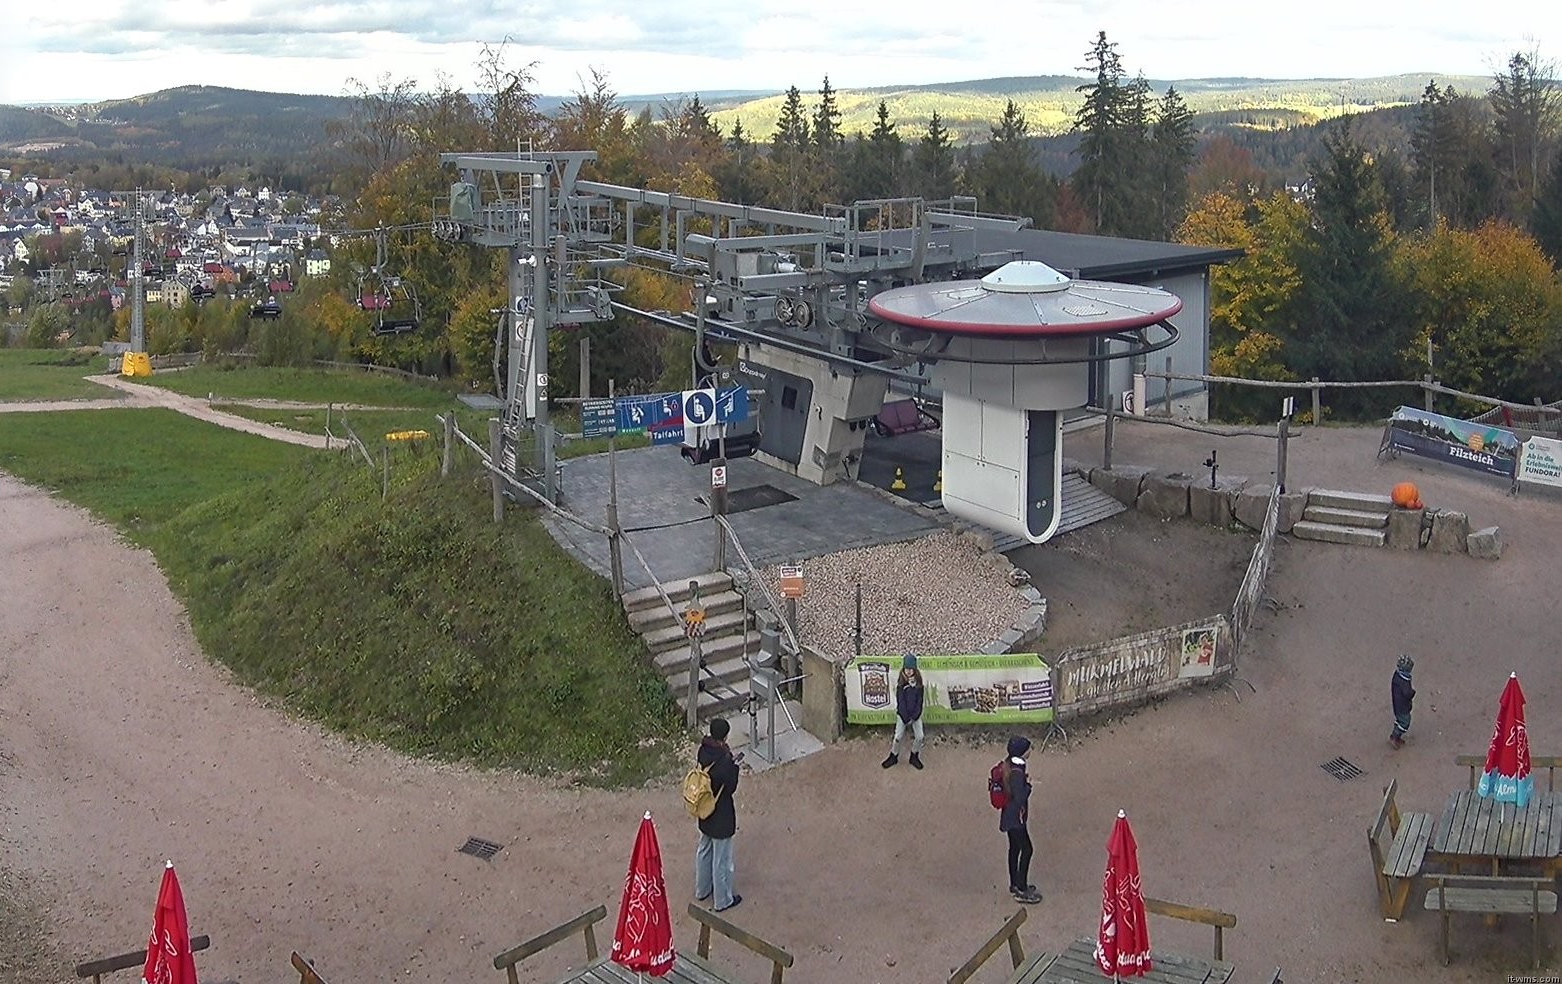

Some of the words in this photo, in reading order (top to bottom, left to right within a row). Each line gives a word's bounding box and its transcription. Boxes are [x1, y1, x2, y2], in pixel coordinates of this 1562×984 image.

[653, 429, 684, 440] Talfahrt
[1449, 446, 1494, 466] Filzteich
[1544, 455, 1555, 463] die
[1525, 467, 1561, 478] FUNDORA!
